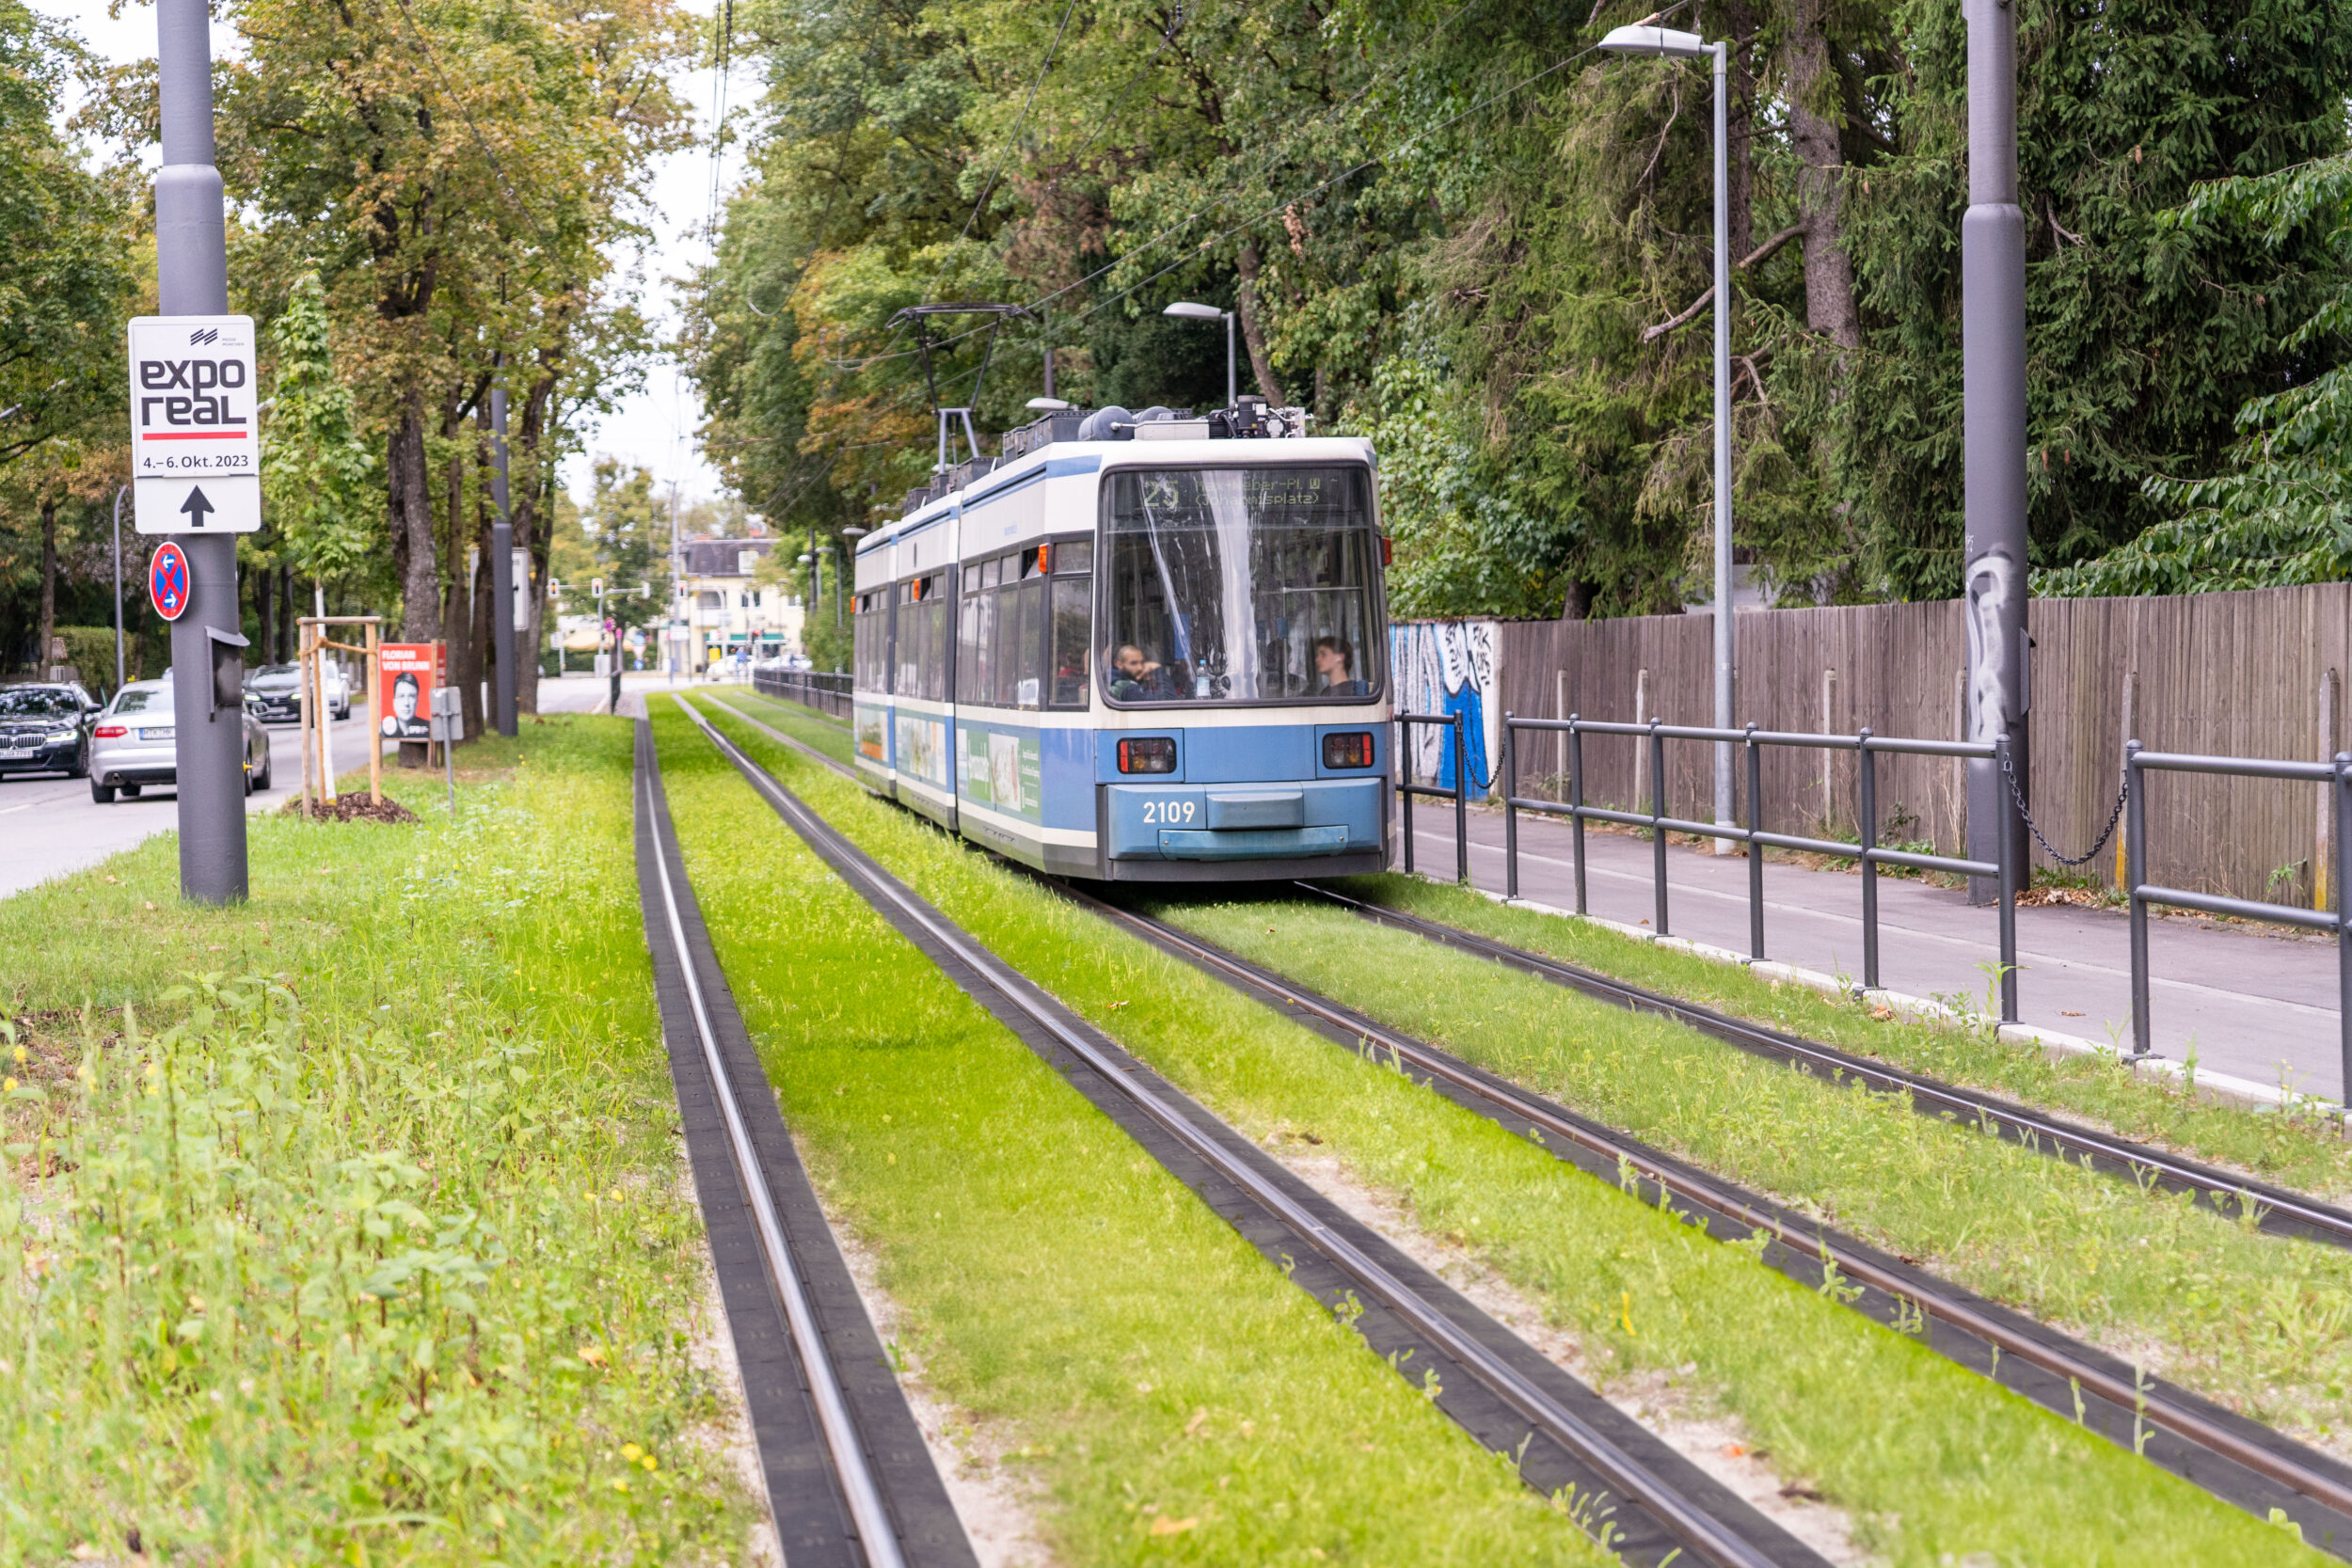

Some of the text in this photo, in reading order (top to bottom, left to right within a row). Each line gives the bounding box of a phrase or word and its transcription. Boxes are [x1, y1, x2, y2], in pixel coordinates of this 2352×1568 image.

[140, 359, 246, 398] expo
[182, 455, 213, 467] Okt.
[215, 455, 248, 467] 2023
[1143, 480, 1179, 507] 25
[382, 661, 401, 671] VON
[1143, 801, 1196, 824] 2109
